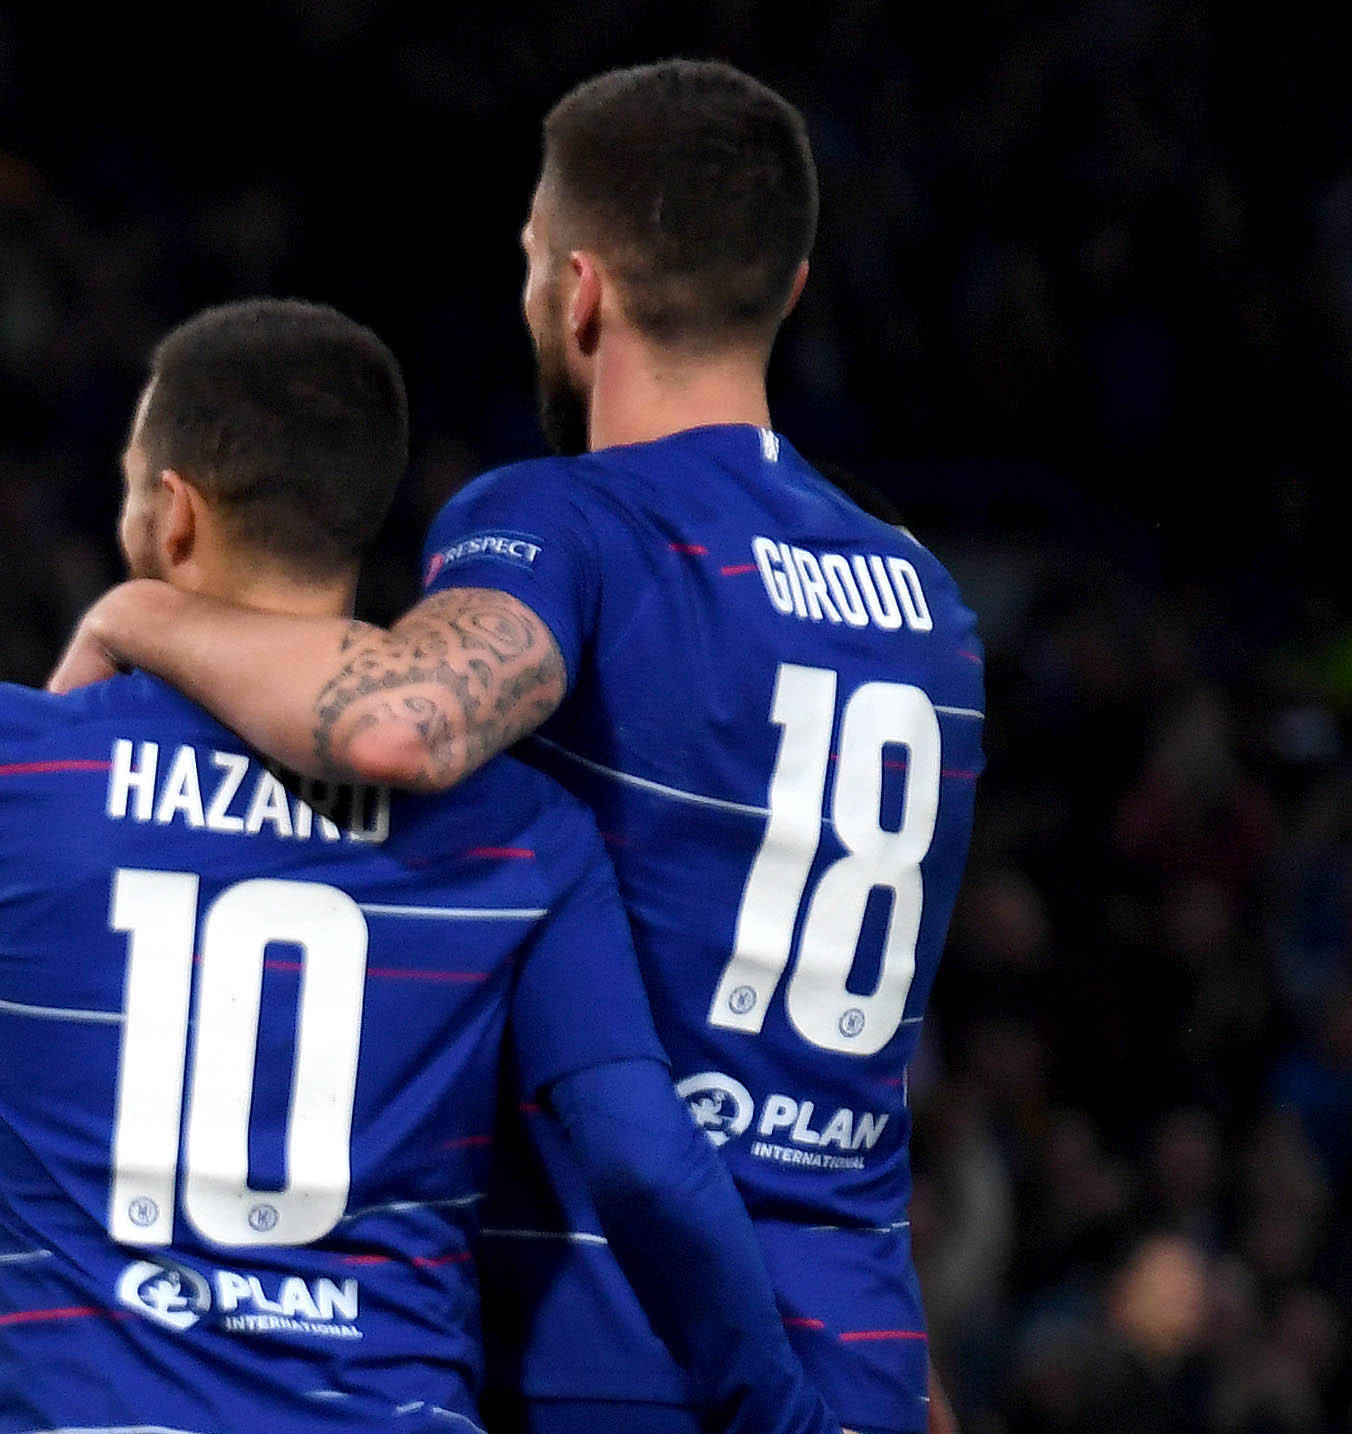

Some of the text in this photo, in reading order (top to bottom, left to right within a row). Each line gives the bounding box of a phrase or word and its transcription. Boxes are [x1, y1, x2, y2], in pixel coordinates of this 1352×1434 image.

[445, 536, 542, 564] RESPECT
[752, 536, 933, 631] GIROUD
[707, 662, 942, 1056] 18
[109, 868, 369, 1247] 10
[758, 1094, 889, 1150] PLAN
[751, 1142, 865, 1169] INTERNATIONAL
[215, 1270, 359, 1320] PLAN
[225, 1315, 363, 1340] INTERNATIONAL
